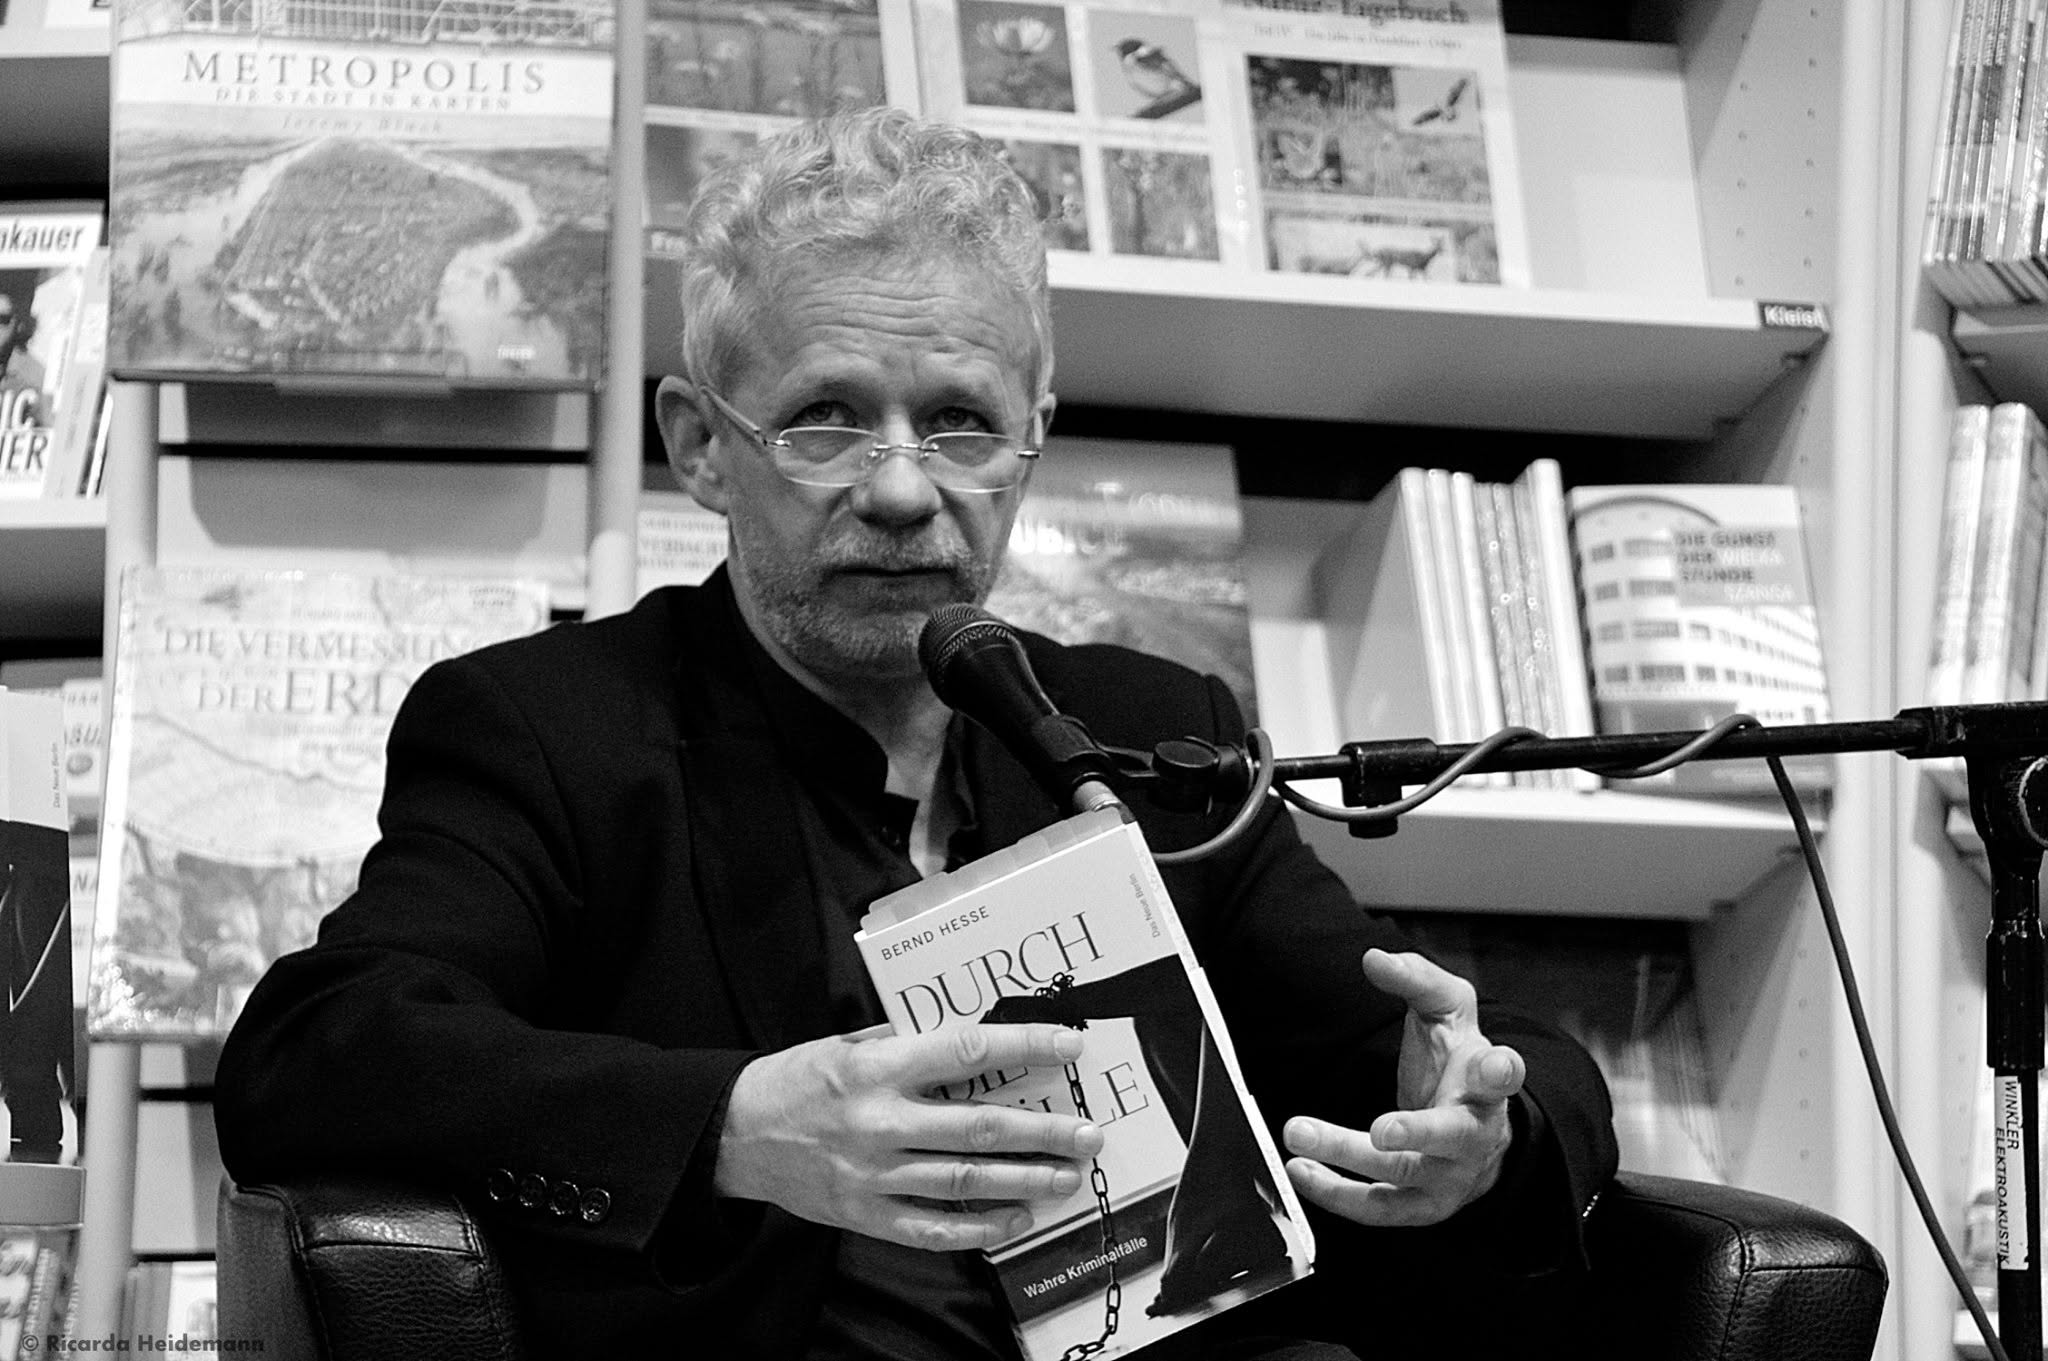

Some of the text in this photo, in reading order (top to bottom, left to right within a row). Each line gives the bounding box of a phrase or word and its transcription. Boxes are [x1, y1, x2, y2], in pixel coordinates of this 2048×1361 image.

[181, 50, 546, 95] METROPOLIS
[215, 86, 512, 112] DIE STADT IN KARTEN
[1680, 566, 1755, 583] STUNDE
[164, 628, 223, 658] DIE
[199, 681, 275, 714] DER
[880, 905, 990, 961] BERND HESSE
[1128, 872, 1161, 939] Das Neue Berlin
[895, 911, 1104, 1034] DURCH
[2005, 1081, 2020, 1150] WINKLER
[1995, 1127, 2010, 1265] ELEKTROAKUSTIK
[1023, 1236, 1149, 1298] Wahre Kriminalfälle
